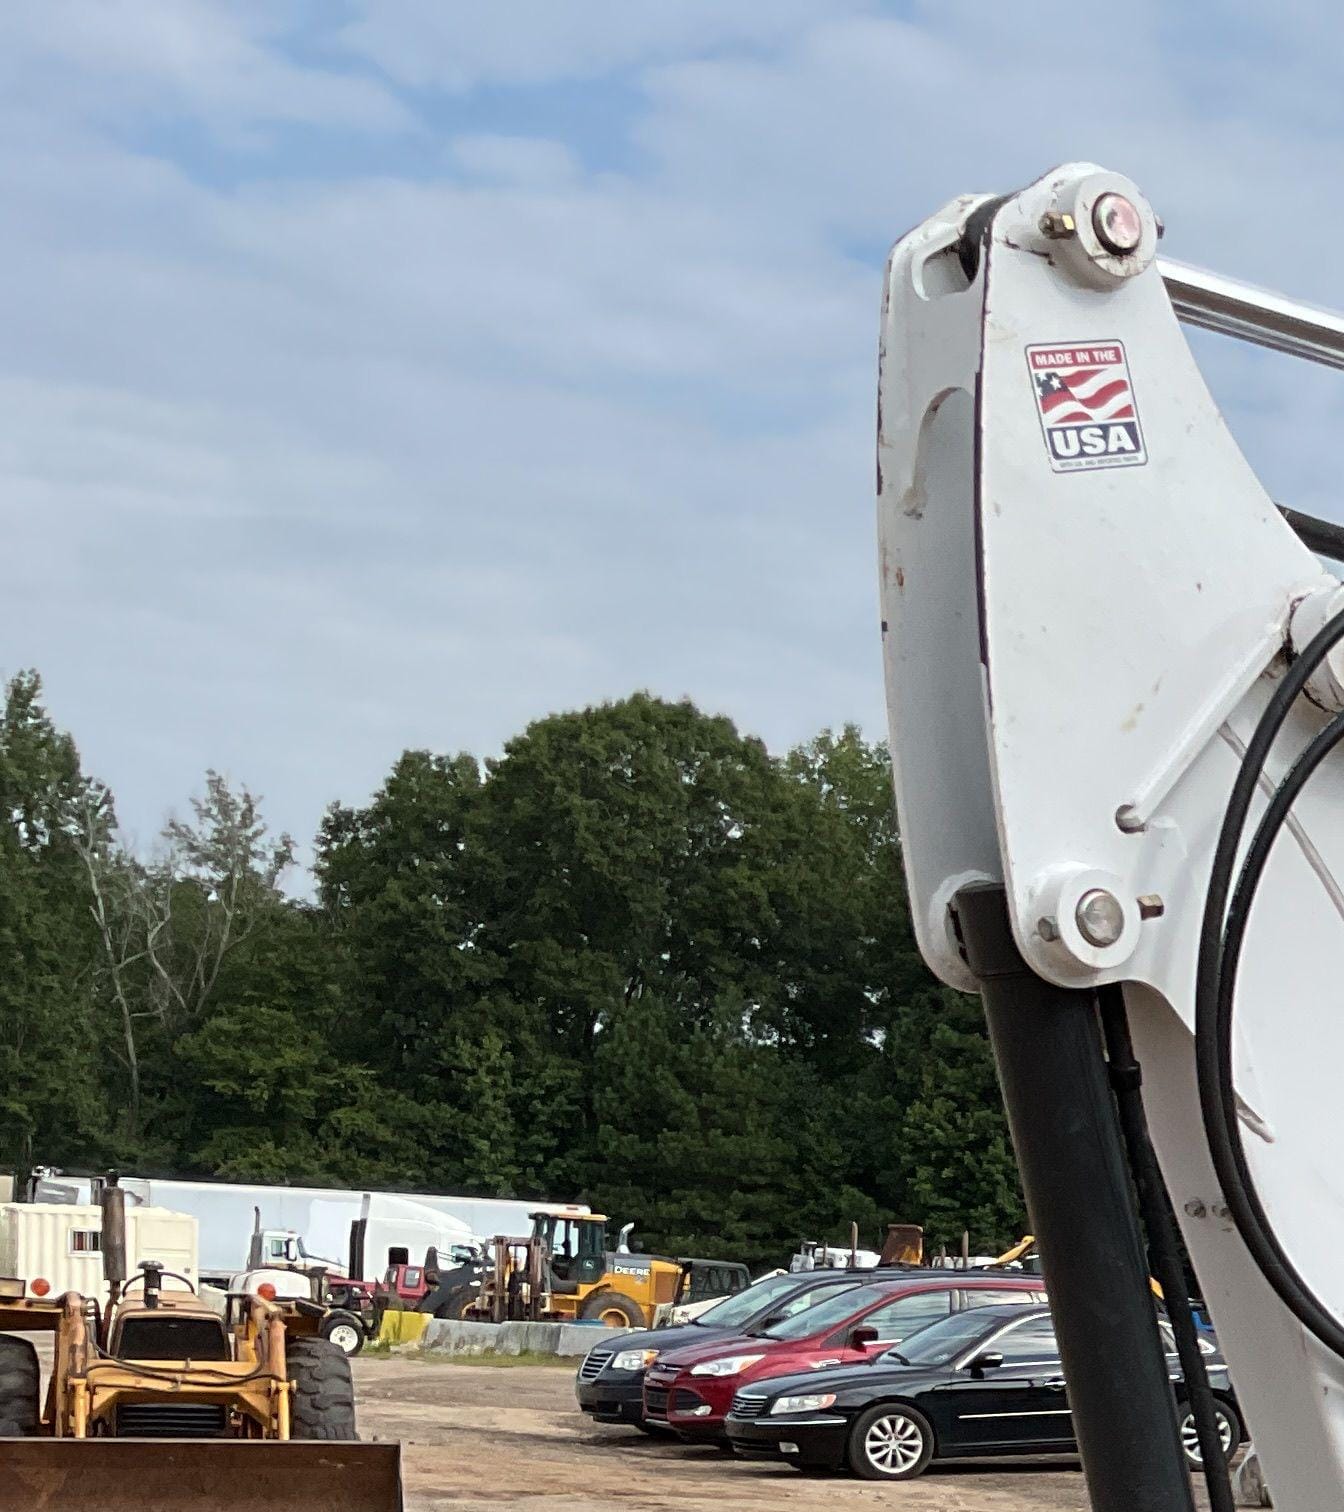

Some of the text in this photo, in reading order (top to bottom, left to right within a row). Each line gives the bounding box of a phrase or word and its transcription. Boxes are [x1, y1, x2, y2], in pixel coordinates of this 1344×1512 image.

[1034, 349, 1117, 366] MADE IN THE
[1051, 424, 1137, 457] USA
[614, 1265, 650, 1276] DEERE
